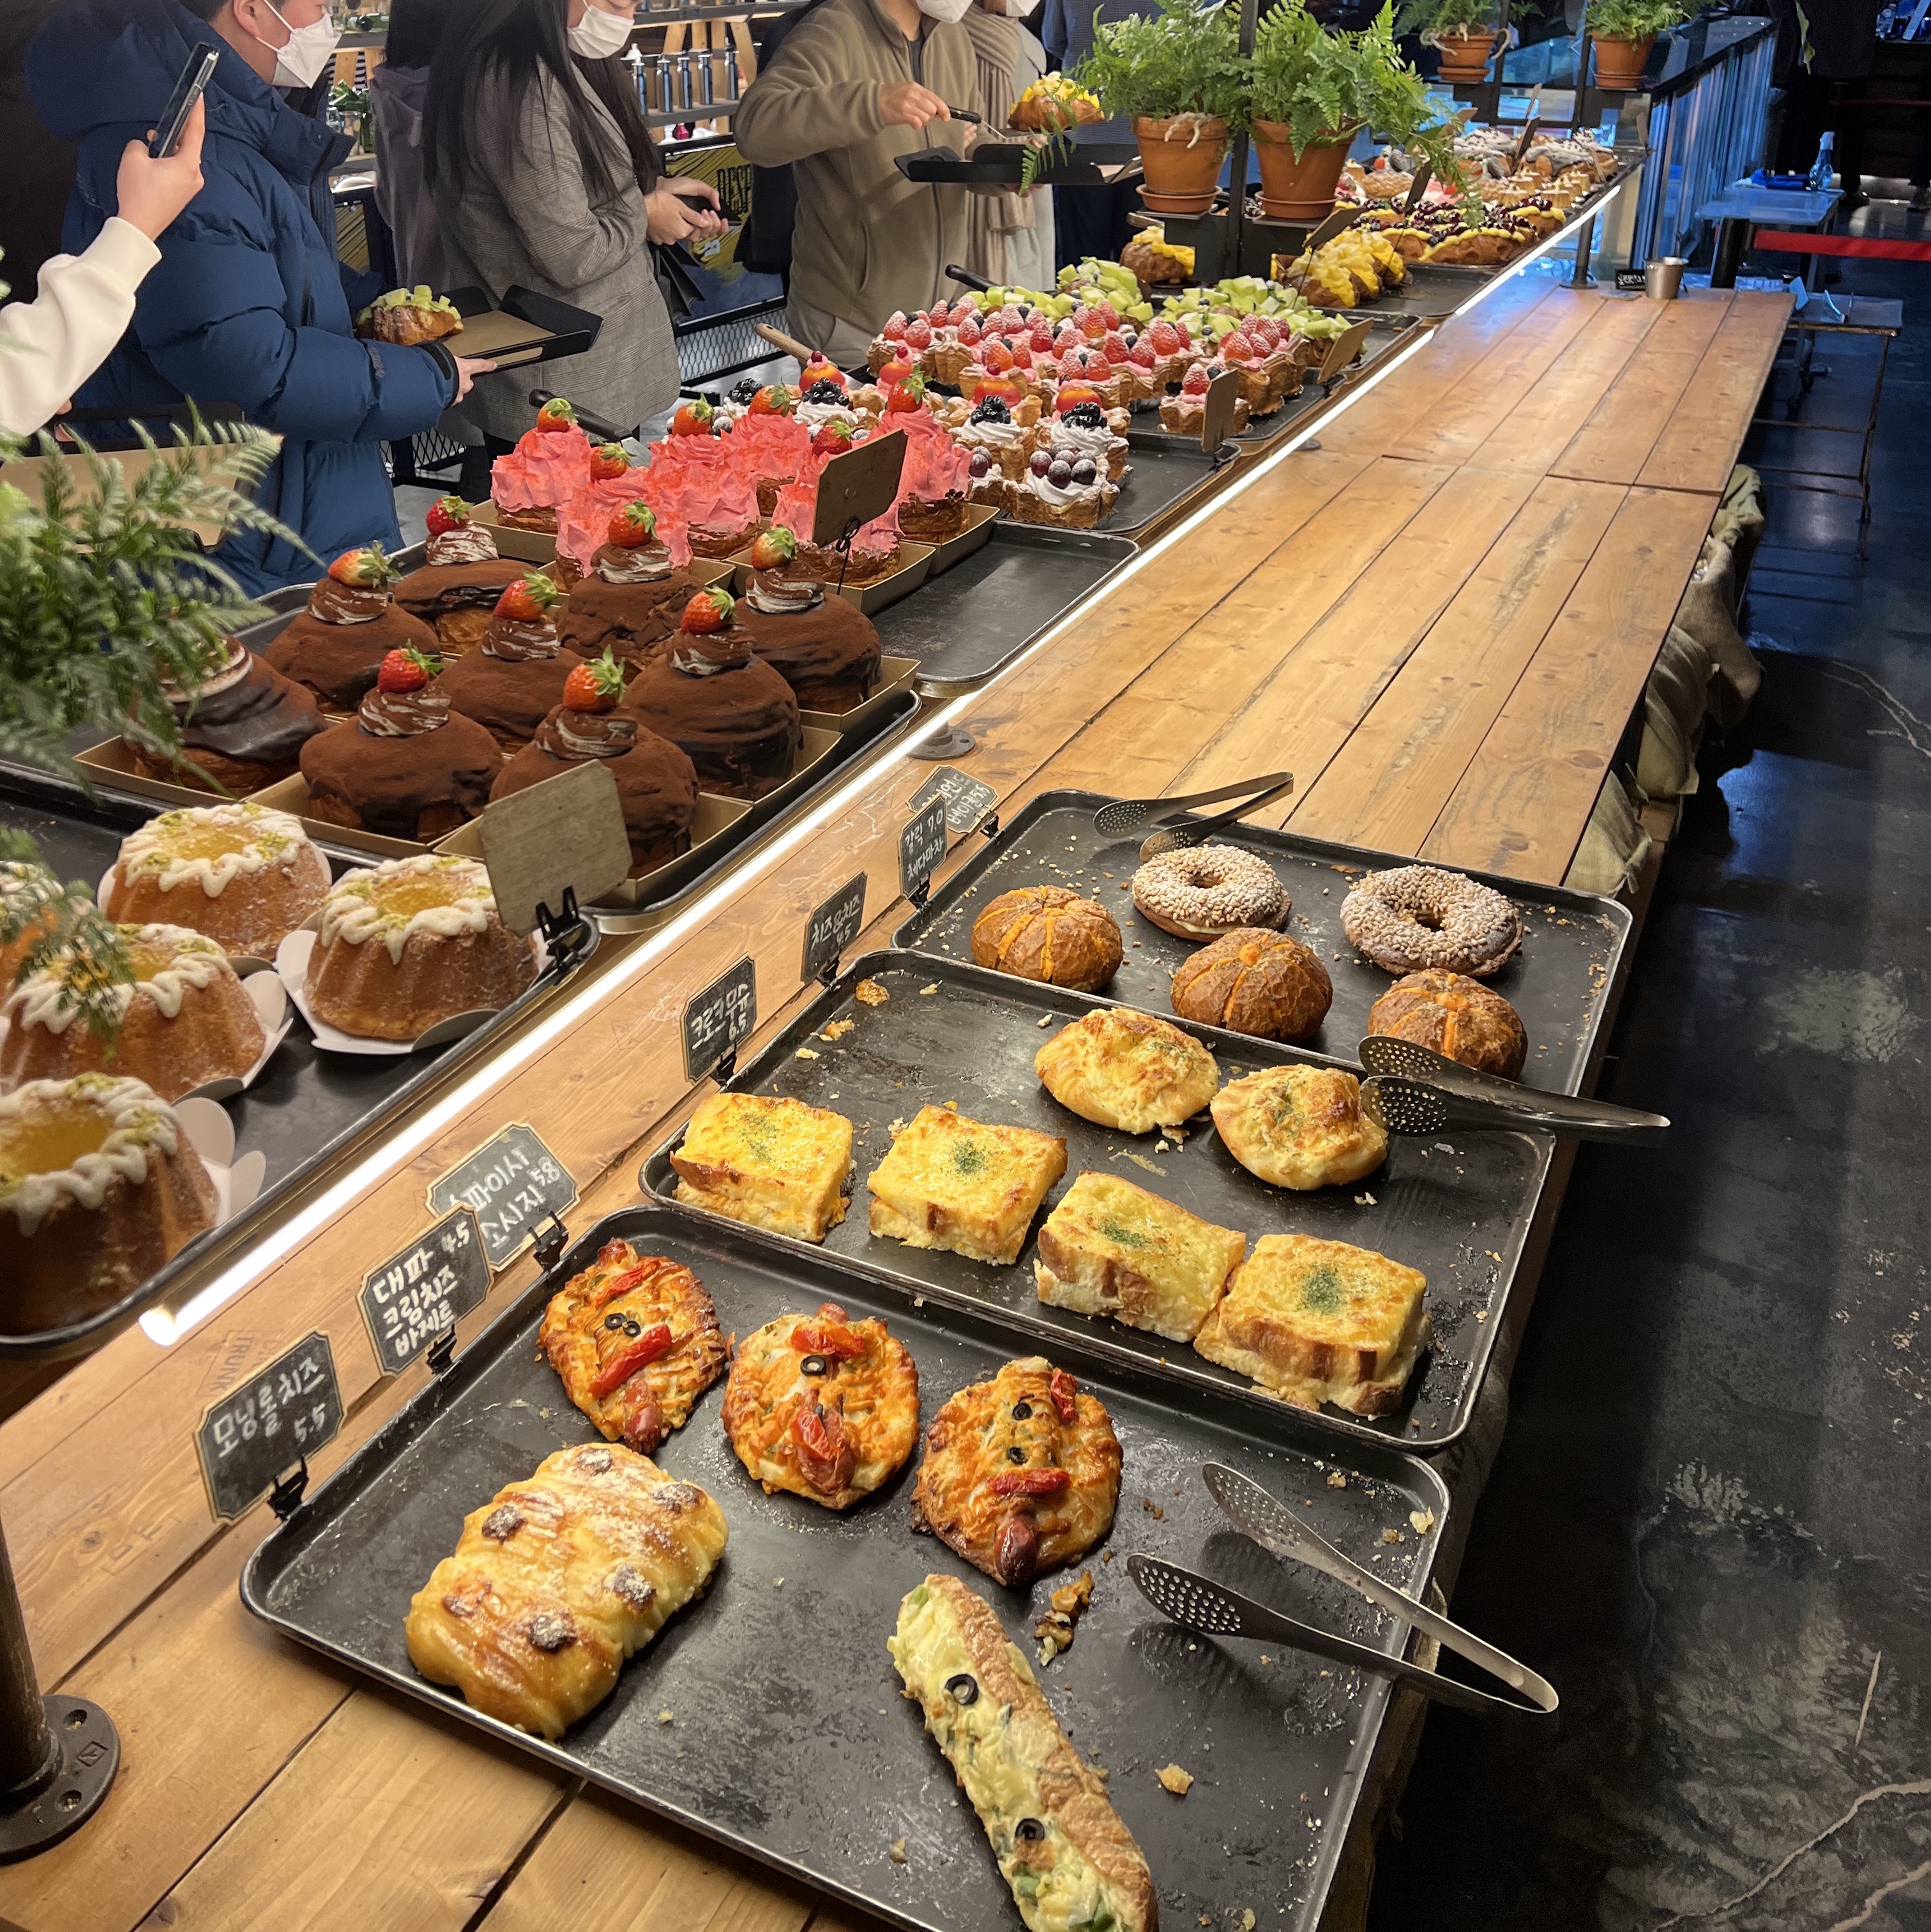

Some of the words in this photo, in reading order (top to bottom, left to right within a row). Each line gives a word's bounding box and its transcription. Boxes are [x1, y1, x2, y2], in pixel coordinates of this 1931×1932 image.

[927, 808, 943, 832] 7.0
[836, 922, 852, 947] 4.5
[728, 1012, 747, 1041] 6.5
[480, 1183, 547, 1248] 소시지
[372, 1247, 435, 1304] 대파
[441, 1221, 470, 1254] 4.5
[395, 1299, 455, 1358] 바게트
[209, 1334, 255, 1392] TRUNK
[294, 1403, 326, 1447] 5.5
